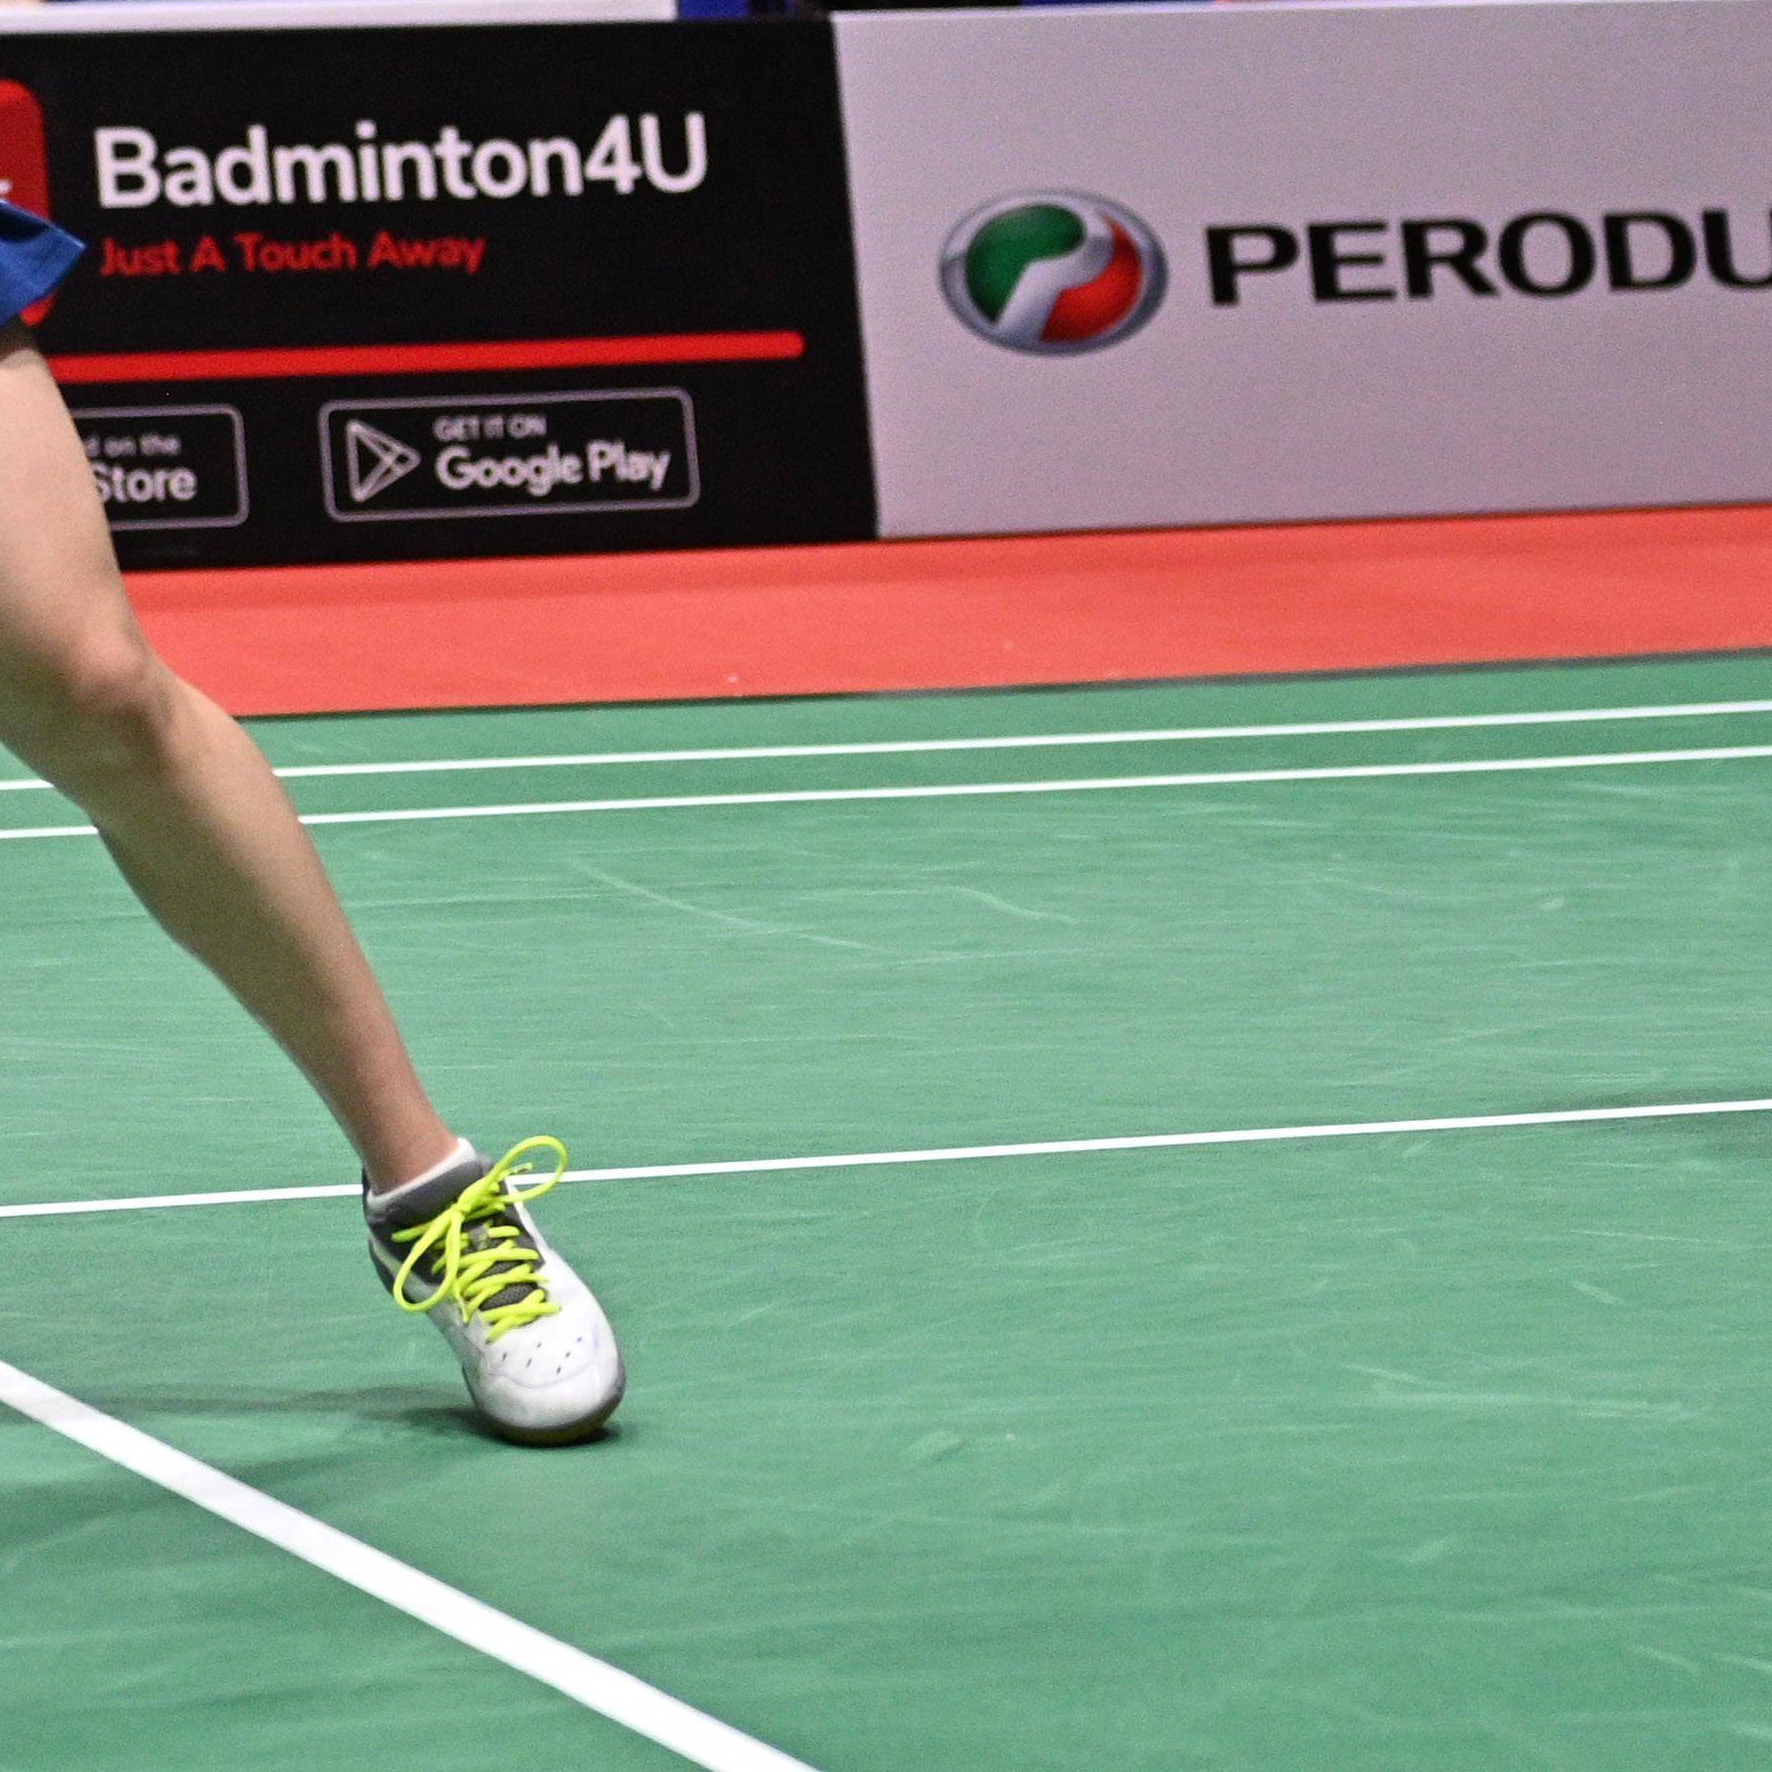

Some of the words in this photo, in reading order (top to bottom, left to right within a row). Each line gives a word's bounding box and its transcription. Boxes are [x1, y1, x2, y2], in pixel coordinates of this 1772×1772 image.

[94, 112, 708, 209] Badminton4U
[100, 237, 181, 277] Just
[189, 235, 226, 273] A
[234, 231, 357, 272] Touch
[368, 230, 487, 275] Away
[433, 415, 480, 442] GET
[507, 413, 547, 439] ON
[90, 461, 198, 503] Store
[435, 441, 584, 497] Google
[586, 439, 672, 492] Play
